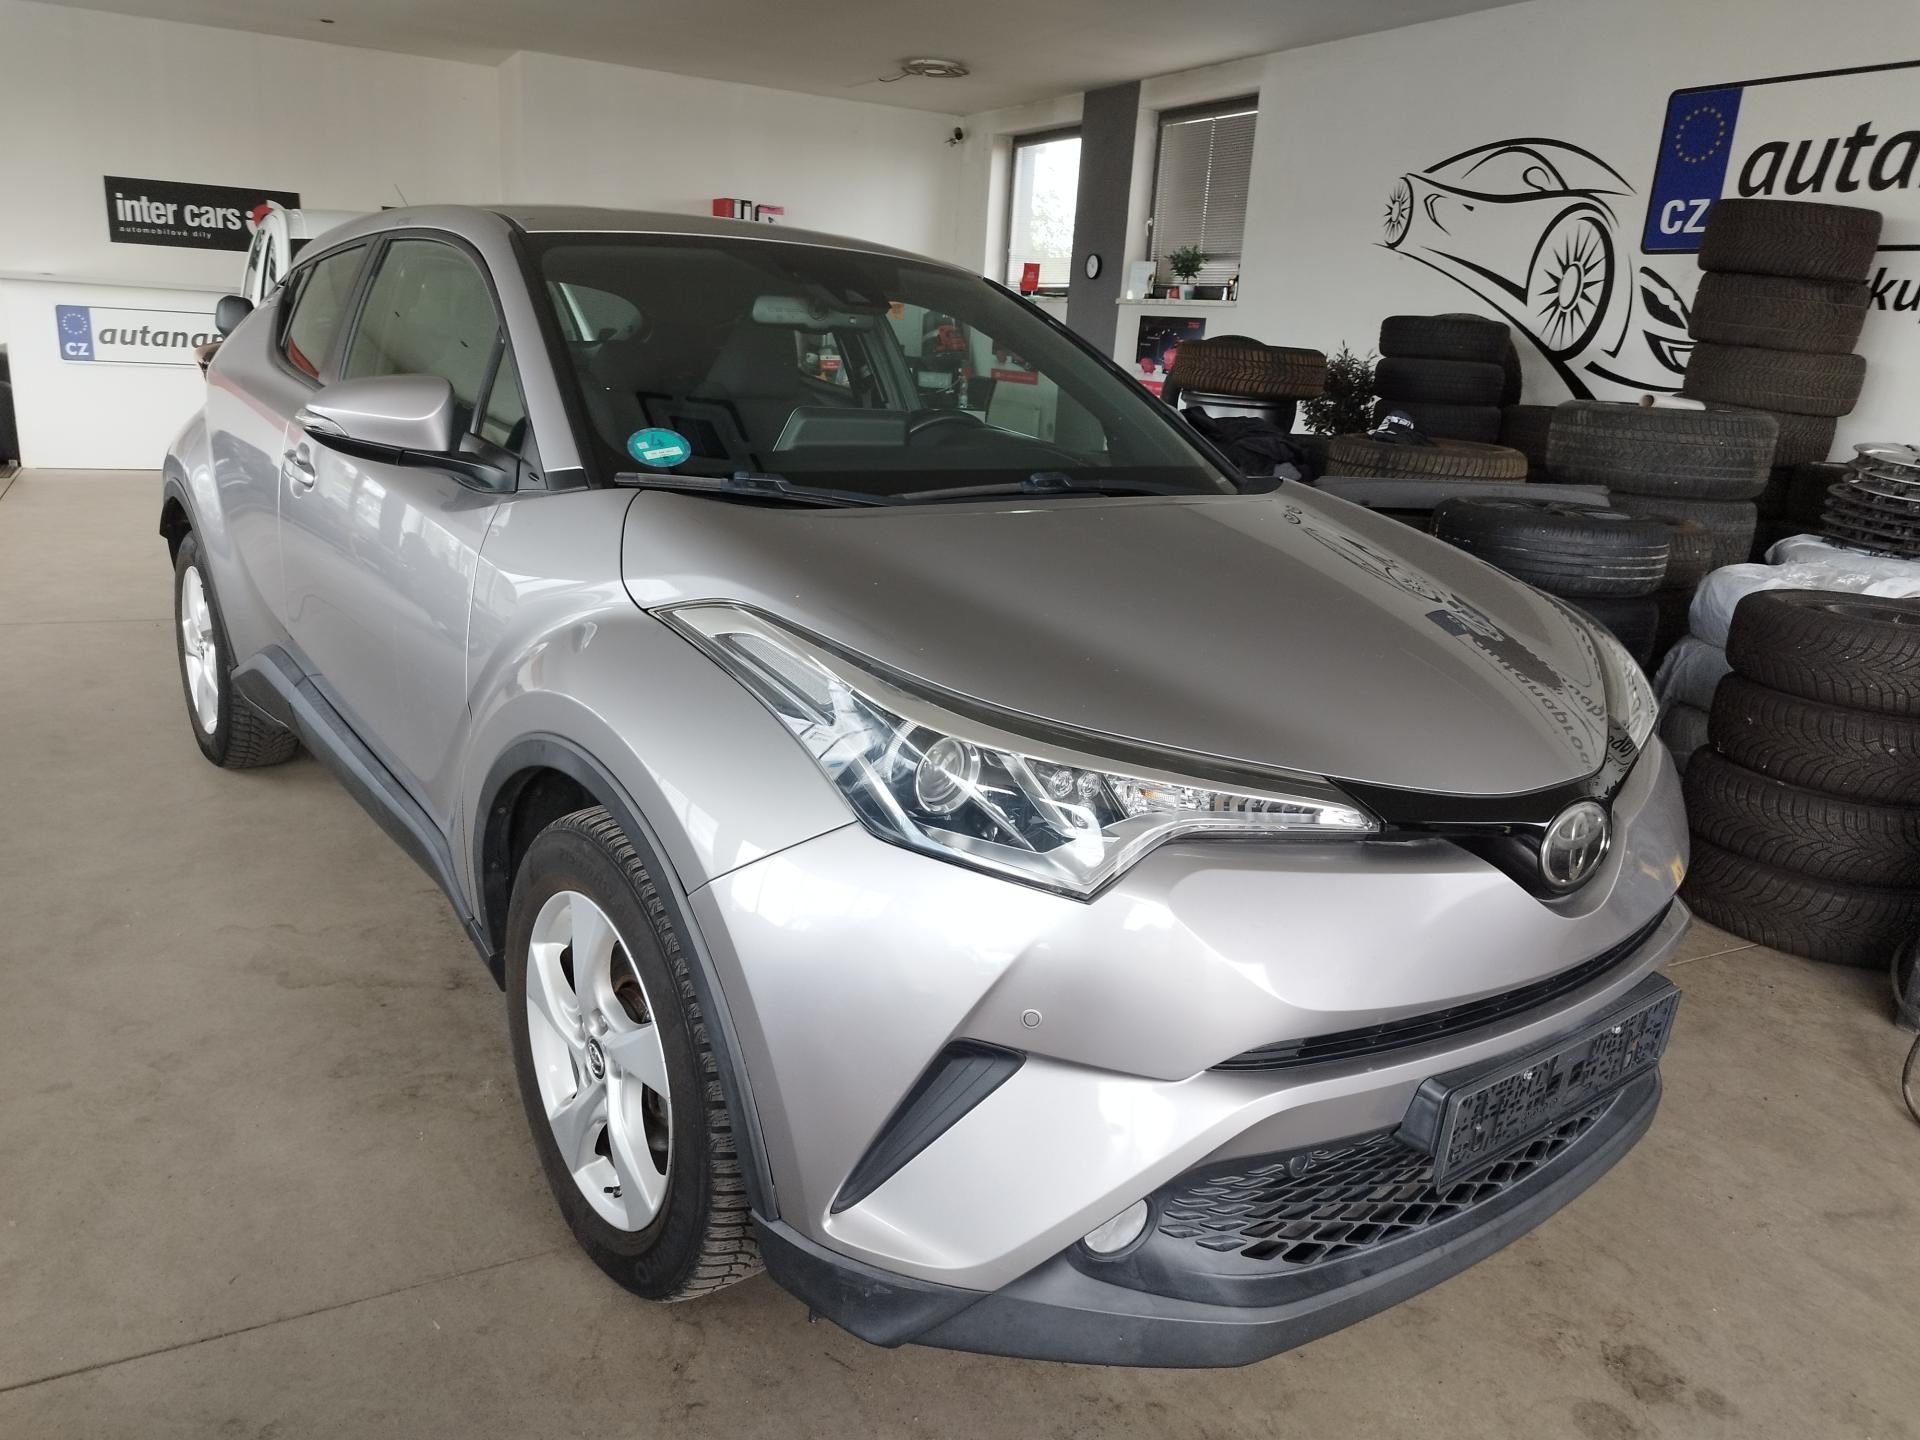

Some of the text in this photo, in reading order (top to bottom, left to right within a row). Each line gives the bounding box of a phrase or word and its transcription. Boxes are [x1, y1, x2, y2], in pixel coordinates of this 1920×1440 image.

[1738, 120, 1920, 198] auta
[115, 193, 242, 230] inter cars
[1659, 198, 1711, 235] CZ
[65, 342, 89, 356] CZ
